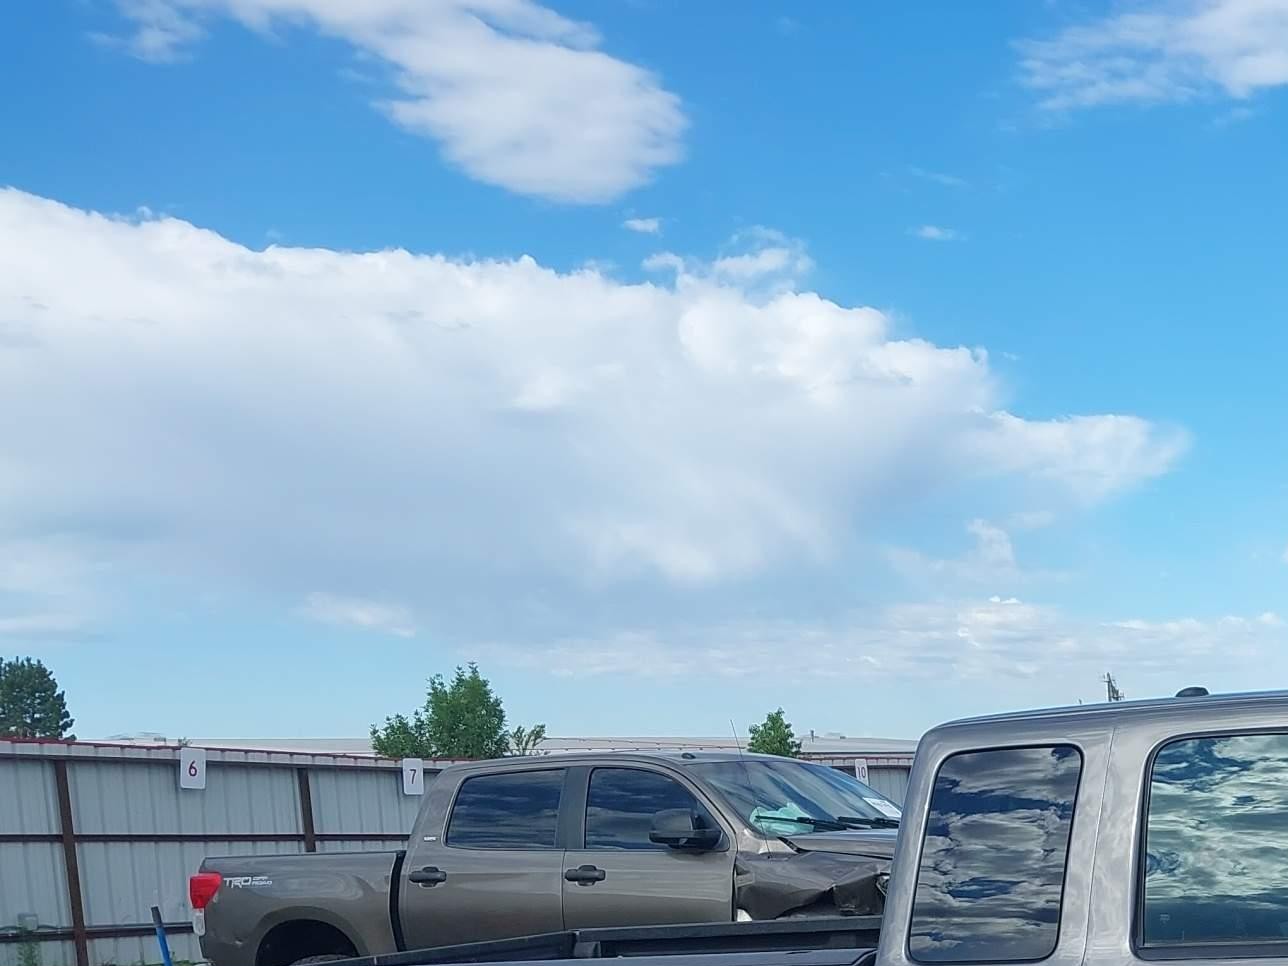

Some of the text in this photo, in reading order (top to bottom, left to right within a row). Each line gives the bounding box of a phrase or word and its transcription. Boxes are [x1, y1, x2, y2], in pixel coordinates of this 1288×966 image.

[188, 760, 198, 777] 6
[857, 766, 867, 778] 10
[409, 768, 418, 785] 7
[223, 877, 251, 889] TRD
